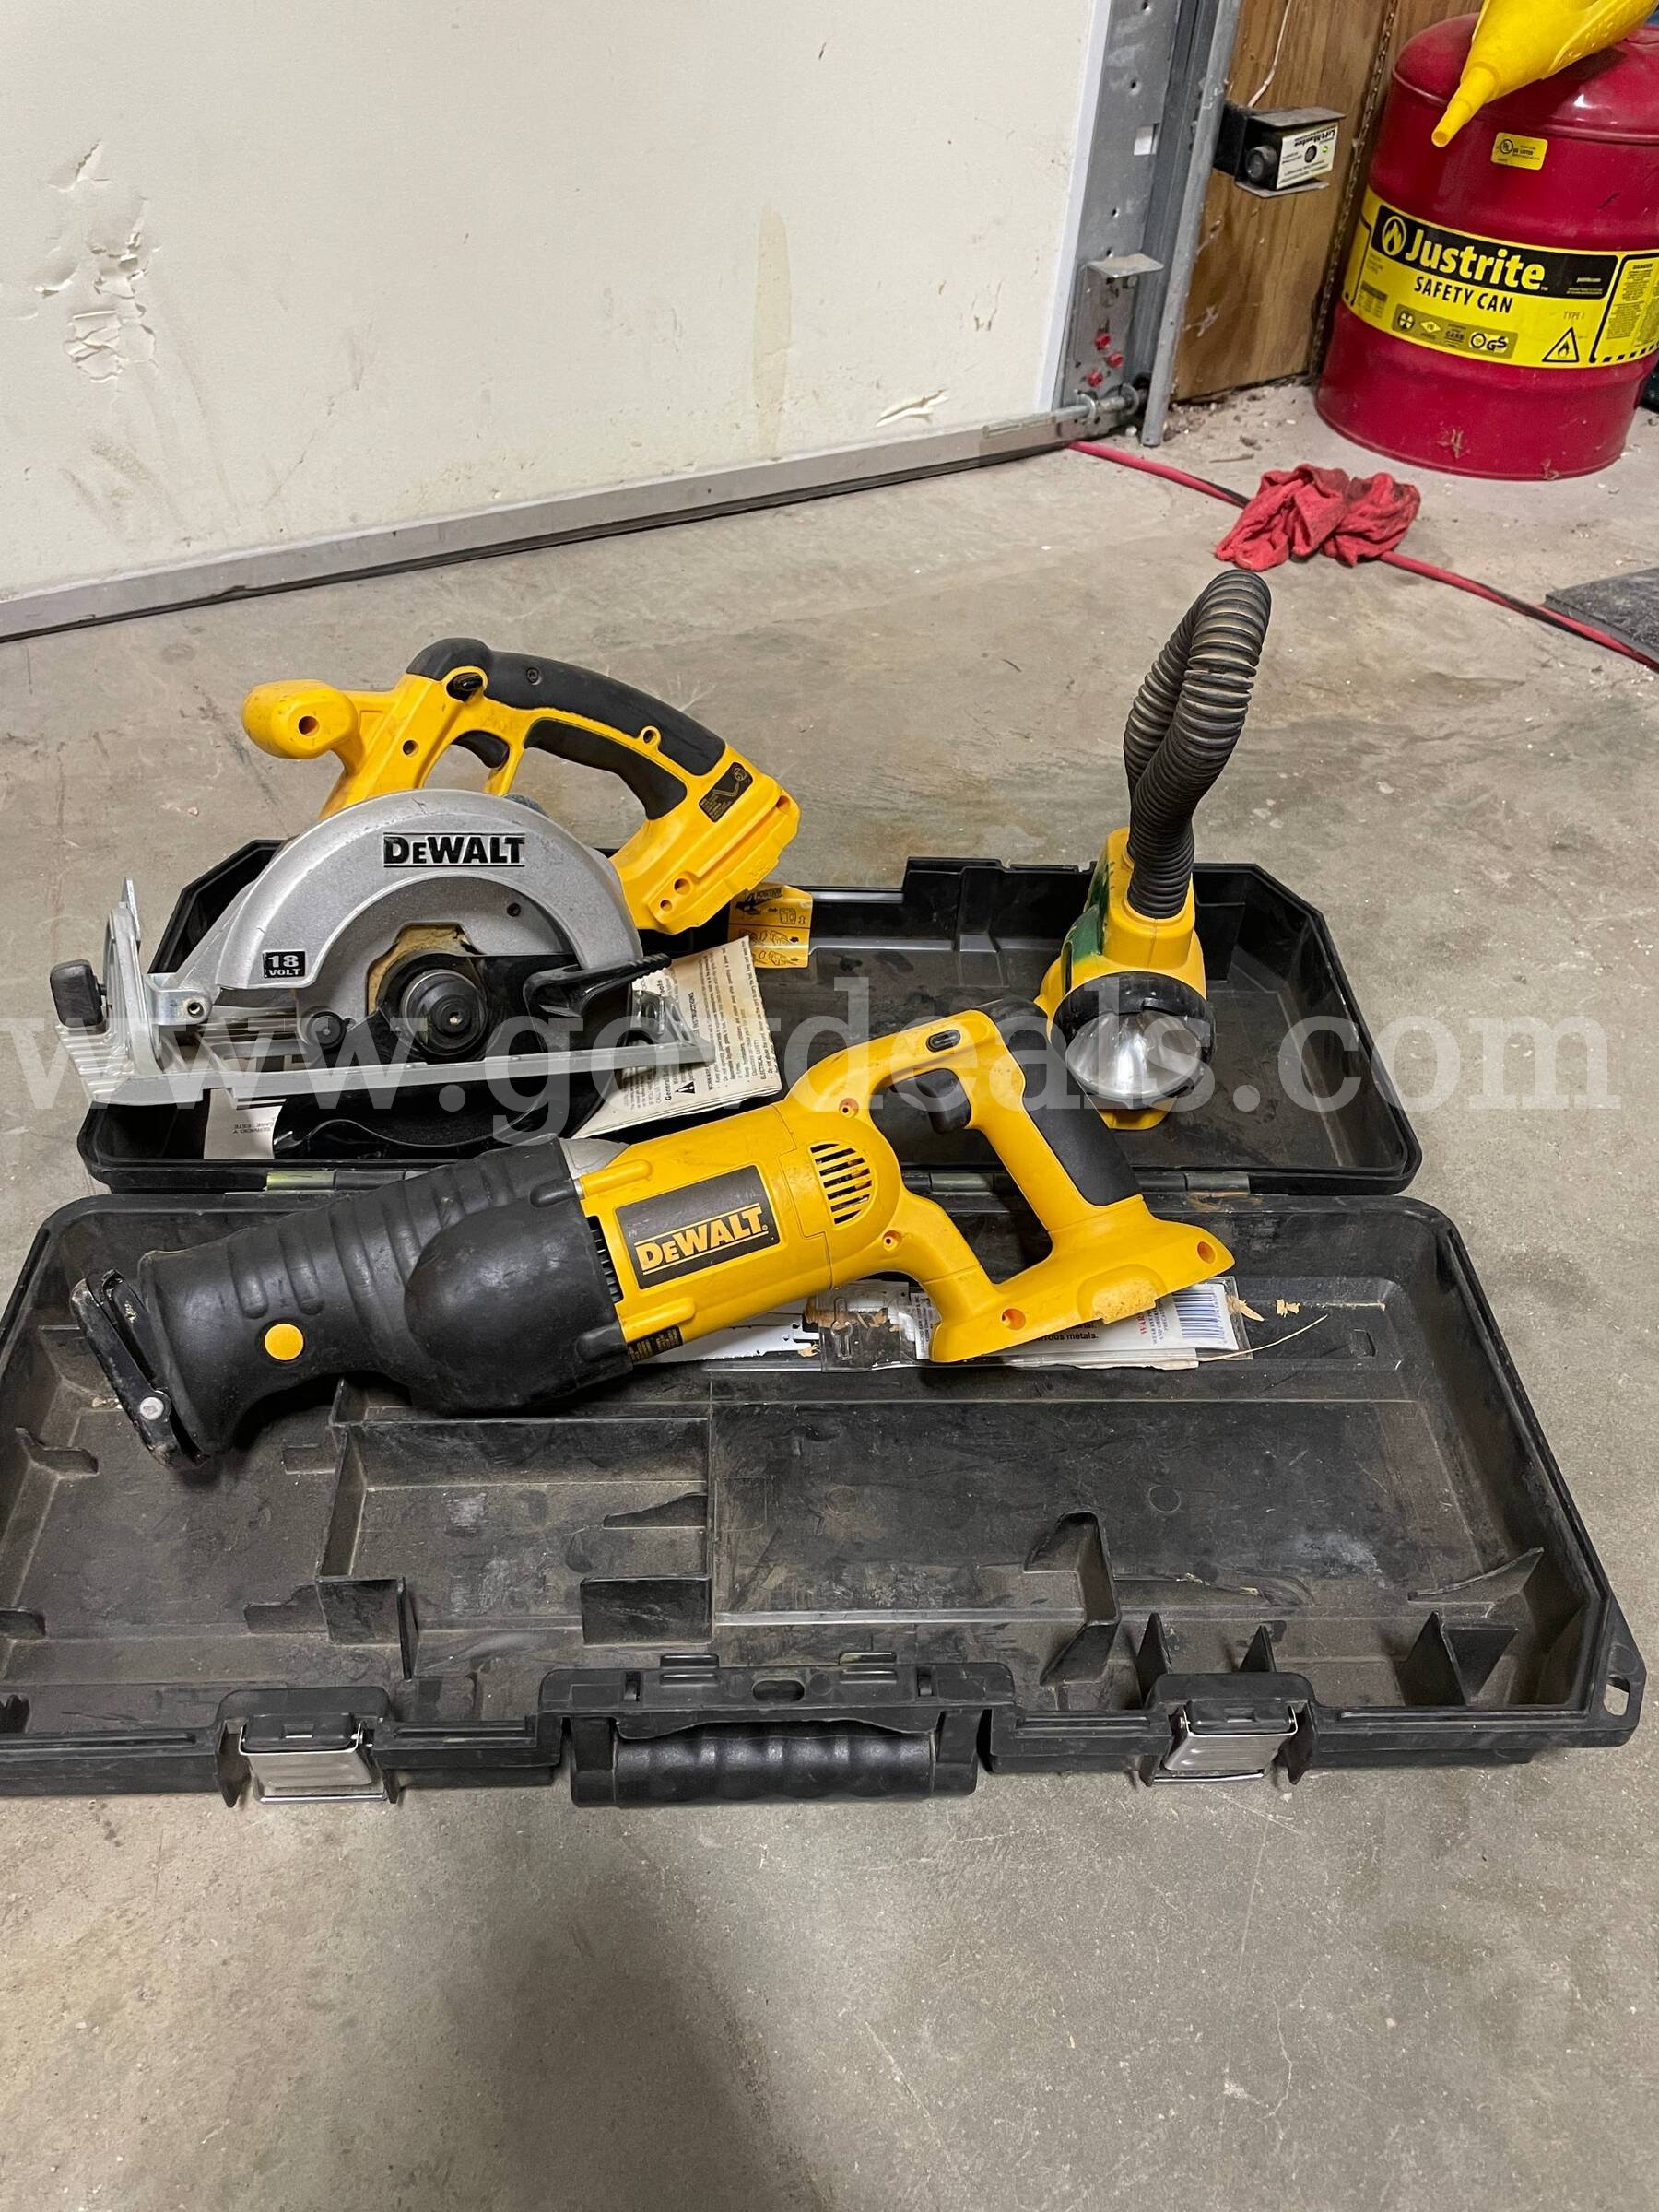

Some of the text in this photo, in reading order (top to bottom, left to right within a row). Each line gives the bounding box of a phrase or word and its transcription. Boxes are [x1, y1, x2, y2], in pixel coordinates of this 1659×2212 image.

[1405, 228, 1546, 291] Justrite
[1414, 276, 1475, 306] SAFETY
[1477, 292, 1513, 313] CAN
[268, 955, 300, 968] 18
[1066, 1331, 1099, 1340] metals.
